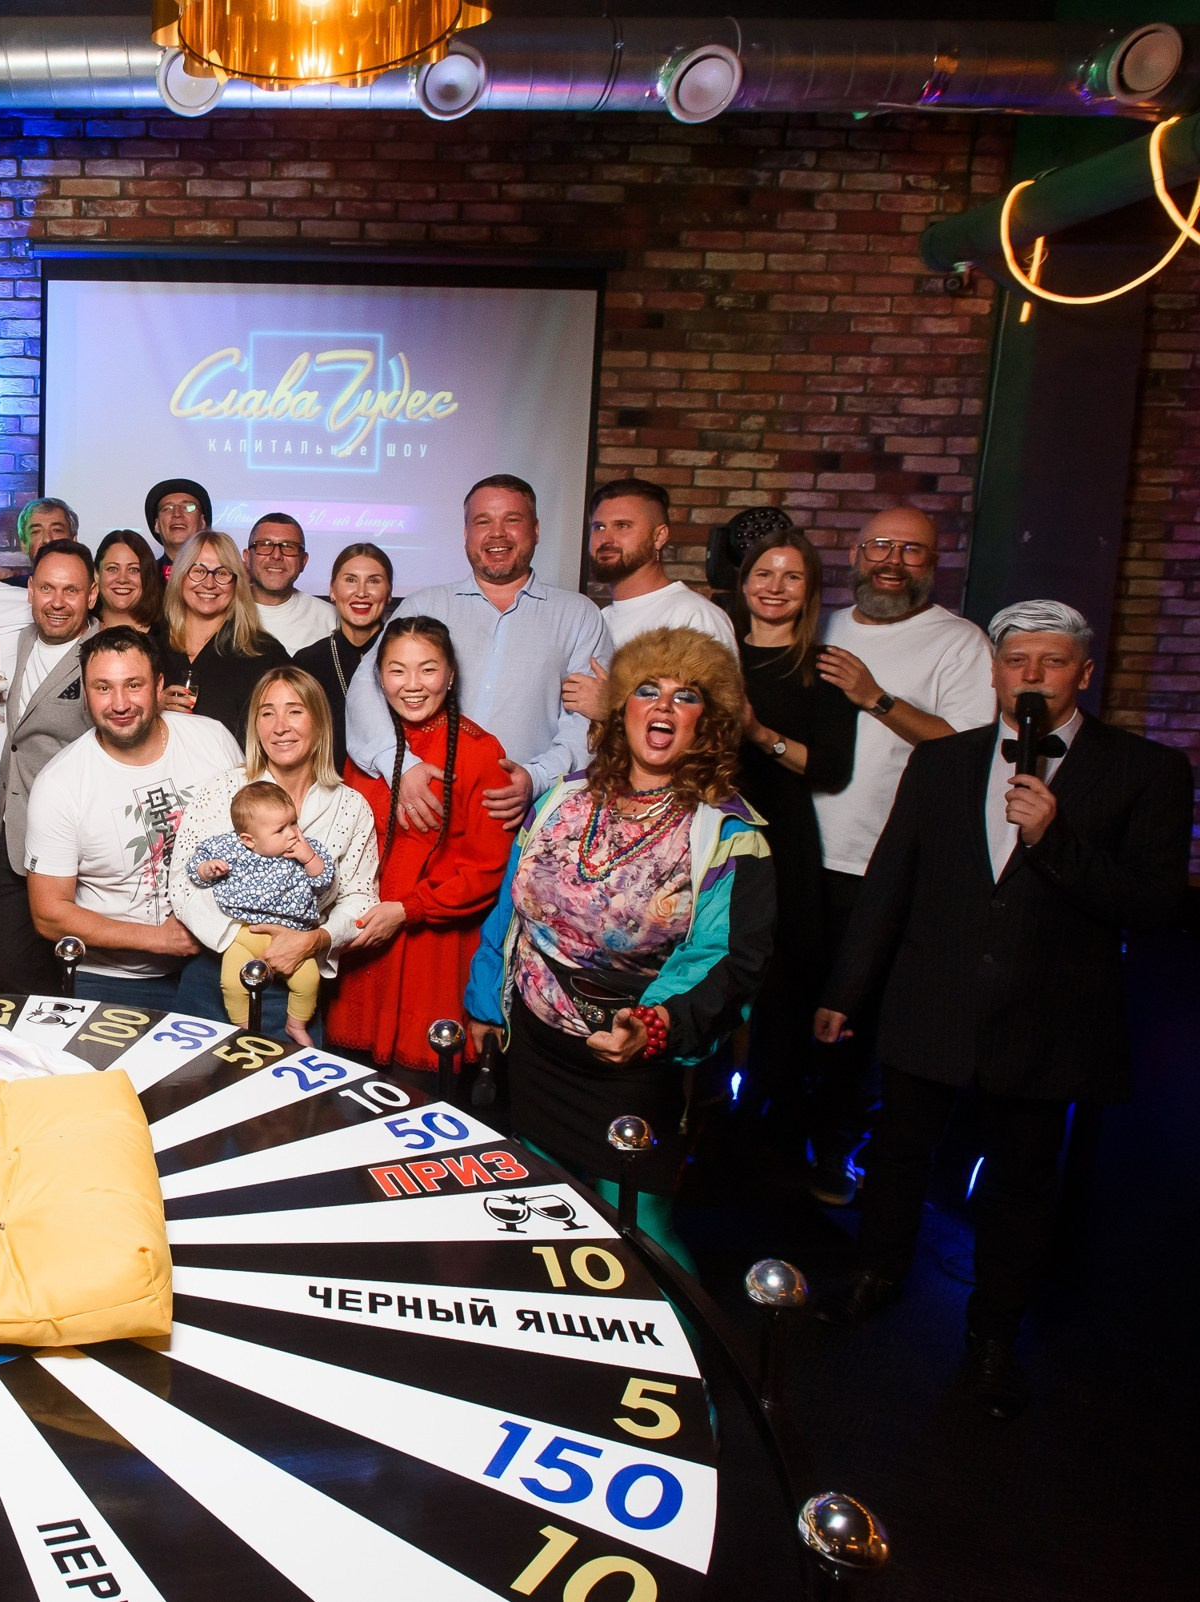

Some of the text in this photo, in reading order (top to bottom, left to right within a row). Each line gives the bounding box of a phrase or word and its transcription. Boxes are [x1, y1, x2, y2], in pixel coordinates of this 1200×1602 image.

[168, 346, 322, 420] Слава
[386, 442, 429, 458] ШОУ
[77, 1008, 152, 1049] 100
[152, 1020, 220, 1052] 30
[212, 1035, 286, 1070] 50
[271, 1054, 349, 1093] 25
[338, 1077, 412, 1116] 10
[383, 1111, 471, 1151] 50
[368, 1149, 530, 1199] ПРИЗ
[531, 1245, 626, 1291] 10
[307, 1284, 665, 1348] ЧЕРНЫЙ ЯЩИК
[612, 1377, 682, 1440] 5
[482, 1420, 684, 1531] 150
